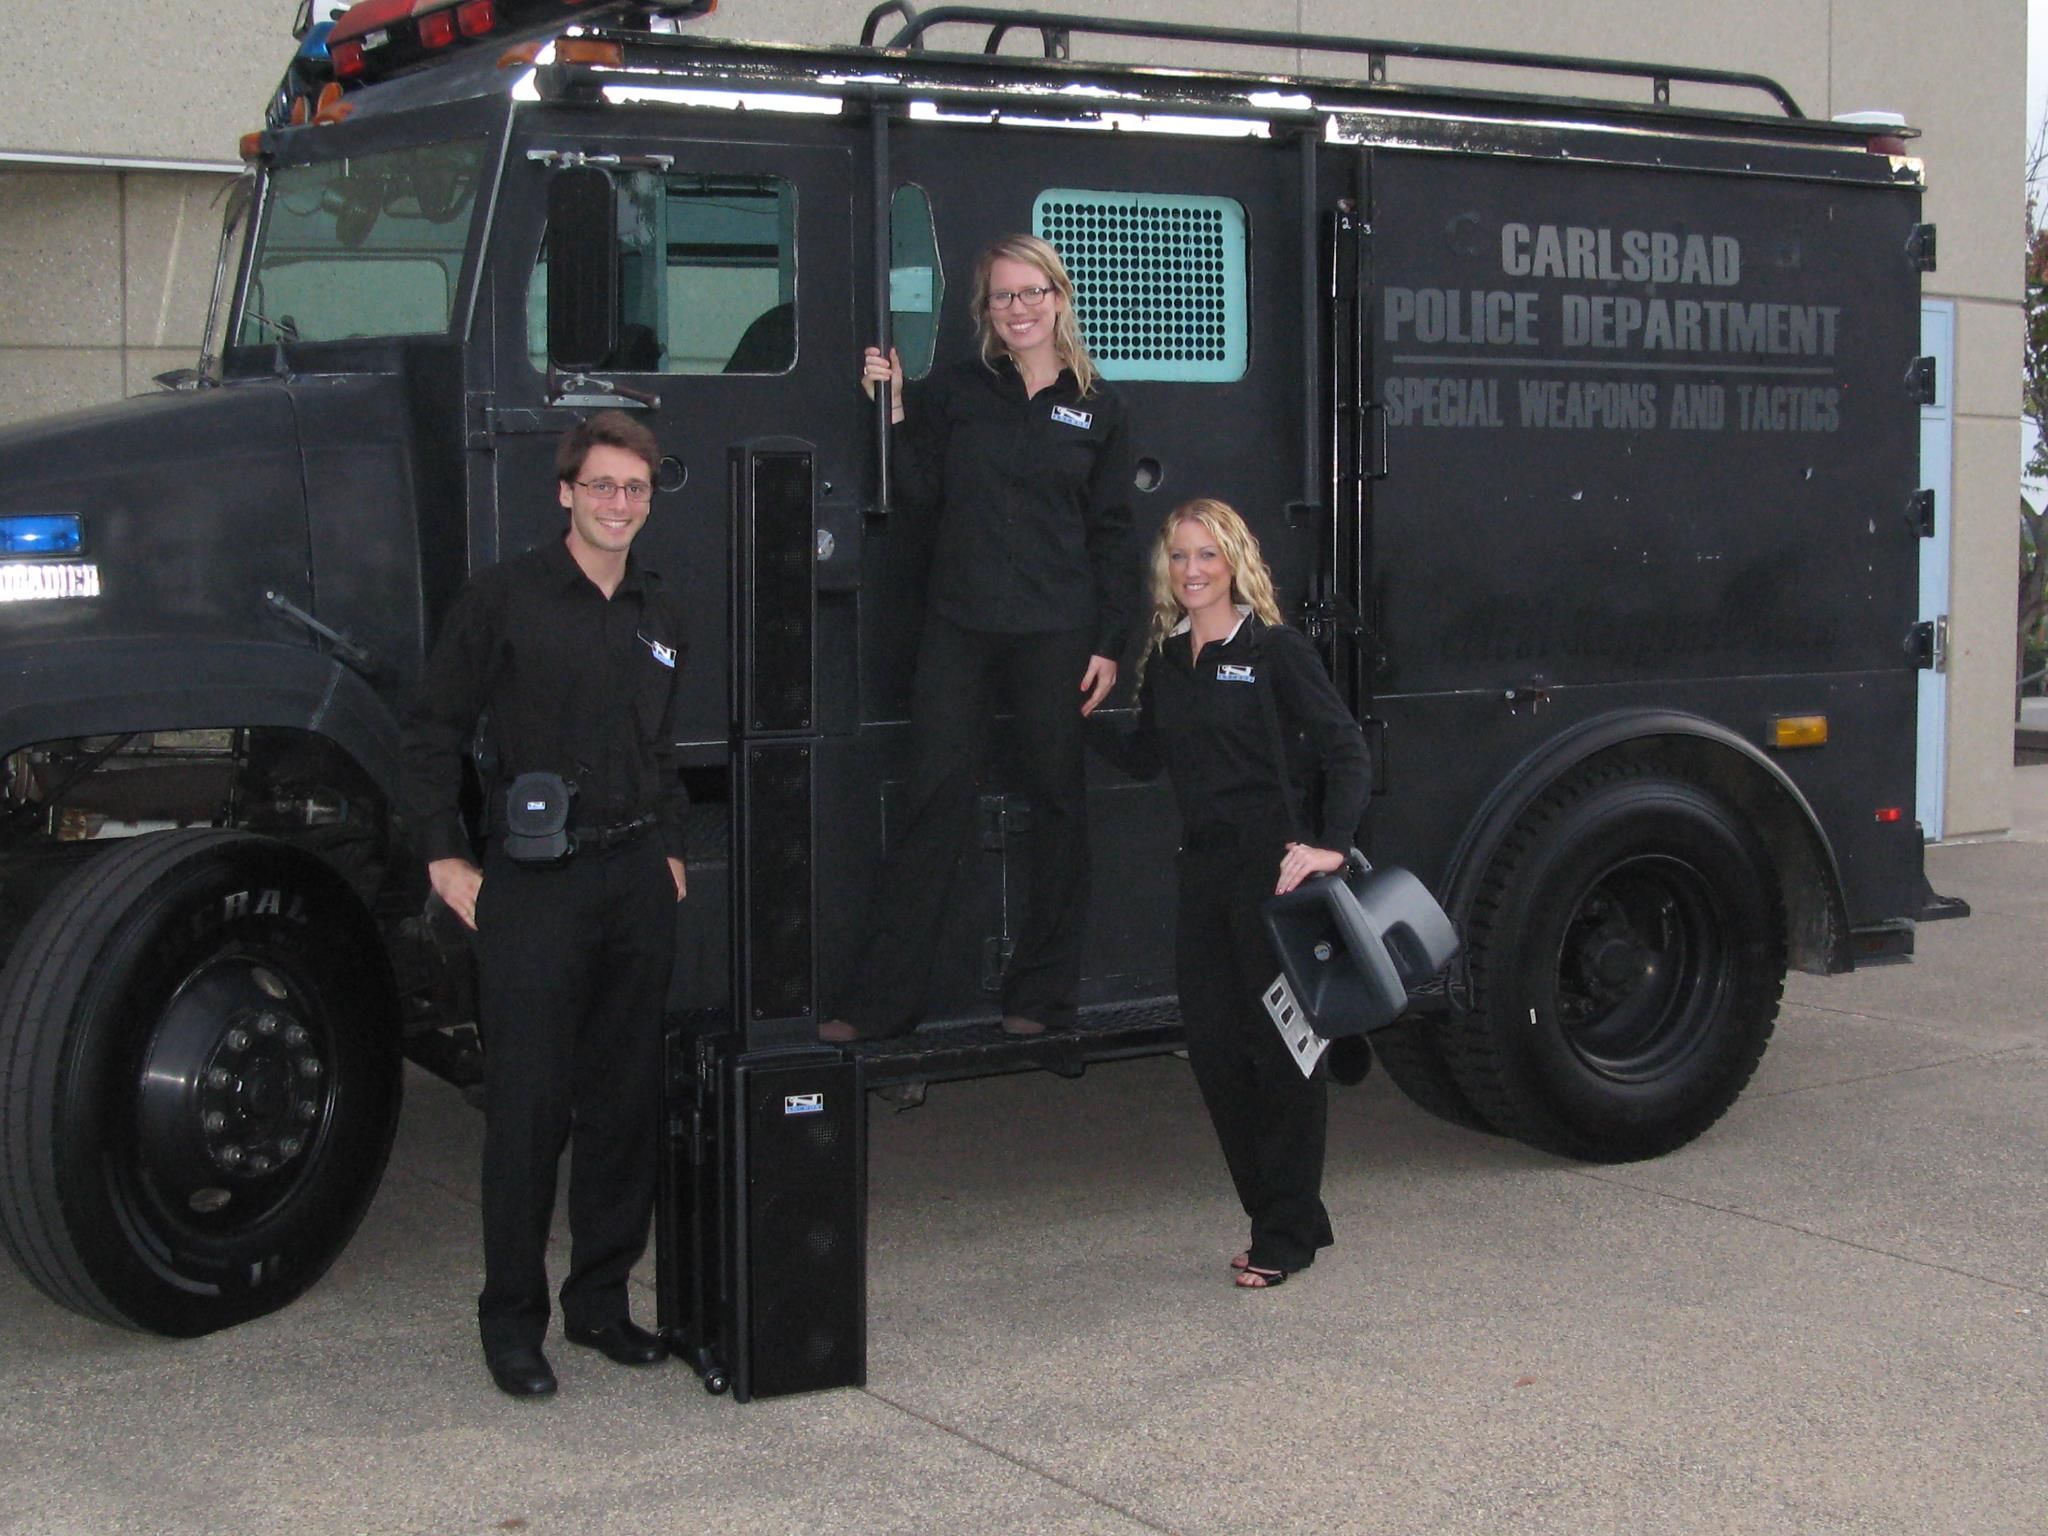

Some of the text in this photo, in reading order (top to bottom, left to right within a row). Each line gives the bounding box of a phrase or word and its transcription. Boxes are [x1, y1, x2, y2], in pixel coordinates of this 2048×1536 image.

[1500, 222, 1741, 287] CARLSBAD
[1384, 287, 1840, 356] POLICE DEPARTMENT
[1383, 377, 1840, 433] SPECIAL WEAPONS AND TACTICS
